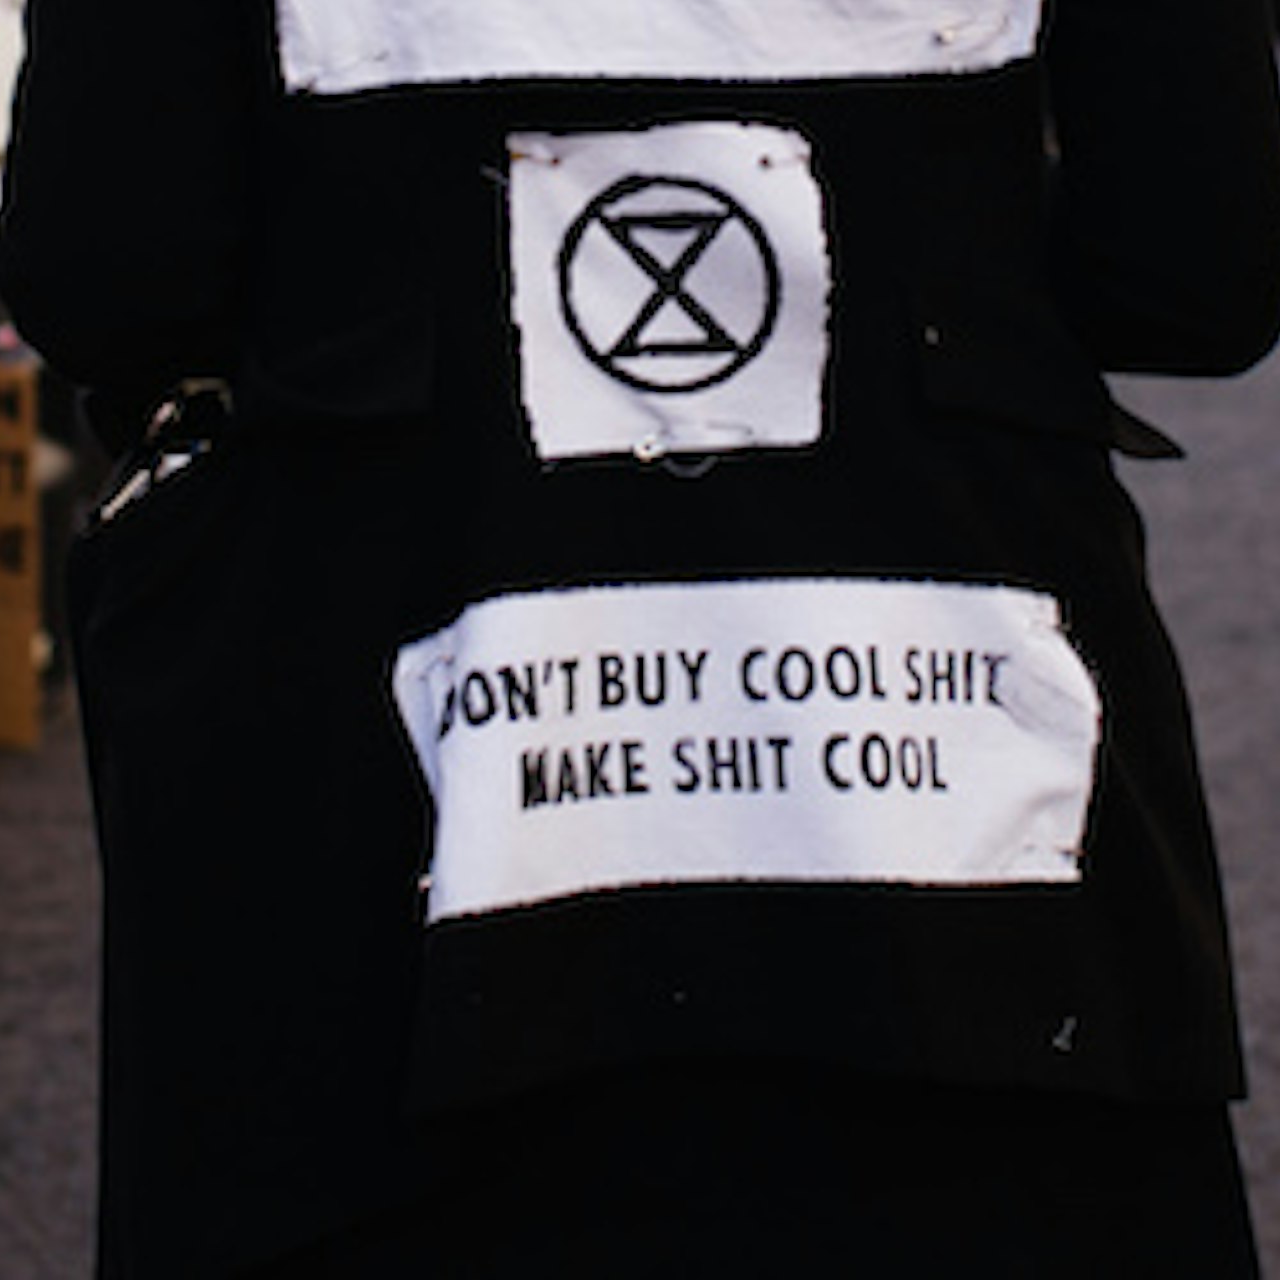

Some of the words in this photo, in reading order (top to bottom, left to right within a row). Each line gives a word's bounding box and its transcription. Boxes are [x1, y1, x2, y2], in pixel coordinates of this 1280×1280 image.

[597, 650, 710, 710] BUY
[739, 645, 887, 704] COOL
[904, 647, 1010, 707] SHIT
[519, 740, 650, 811] MAKE
[672, 736, 793, 795] SHIT
[821, 732, 949, 793] COOL
